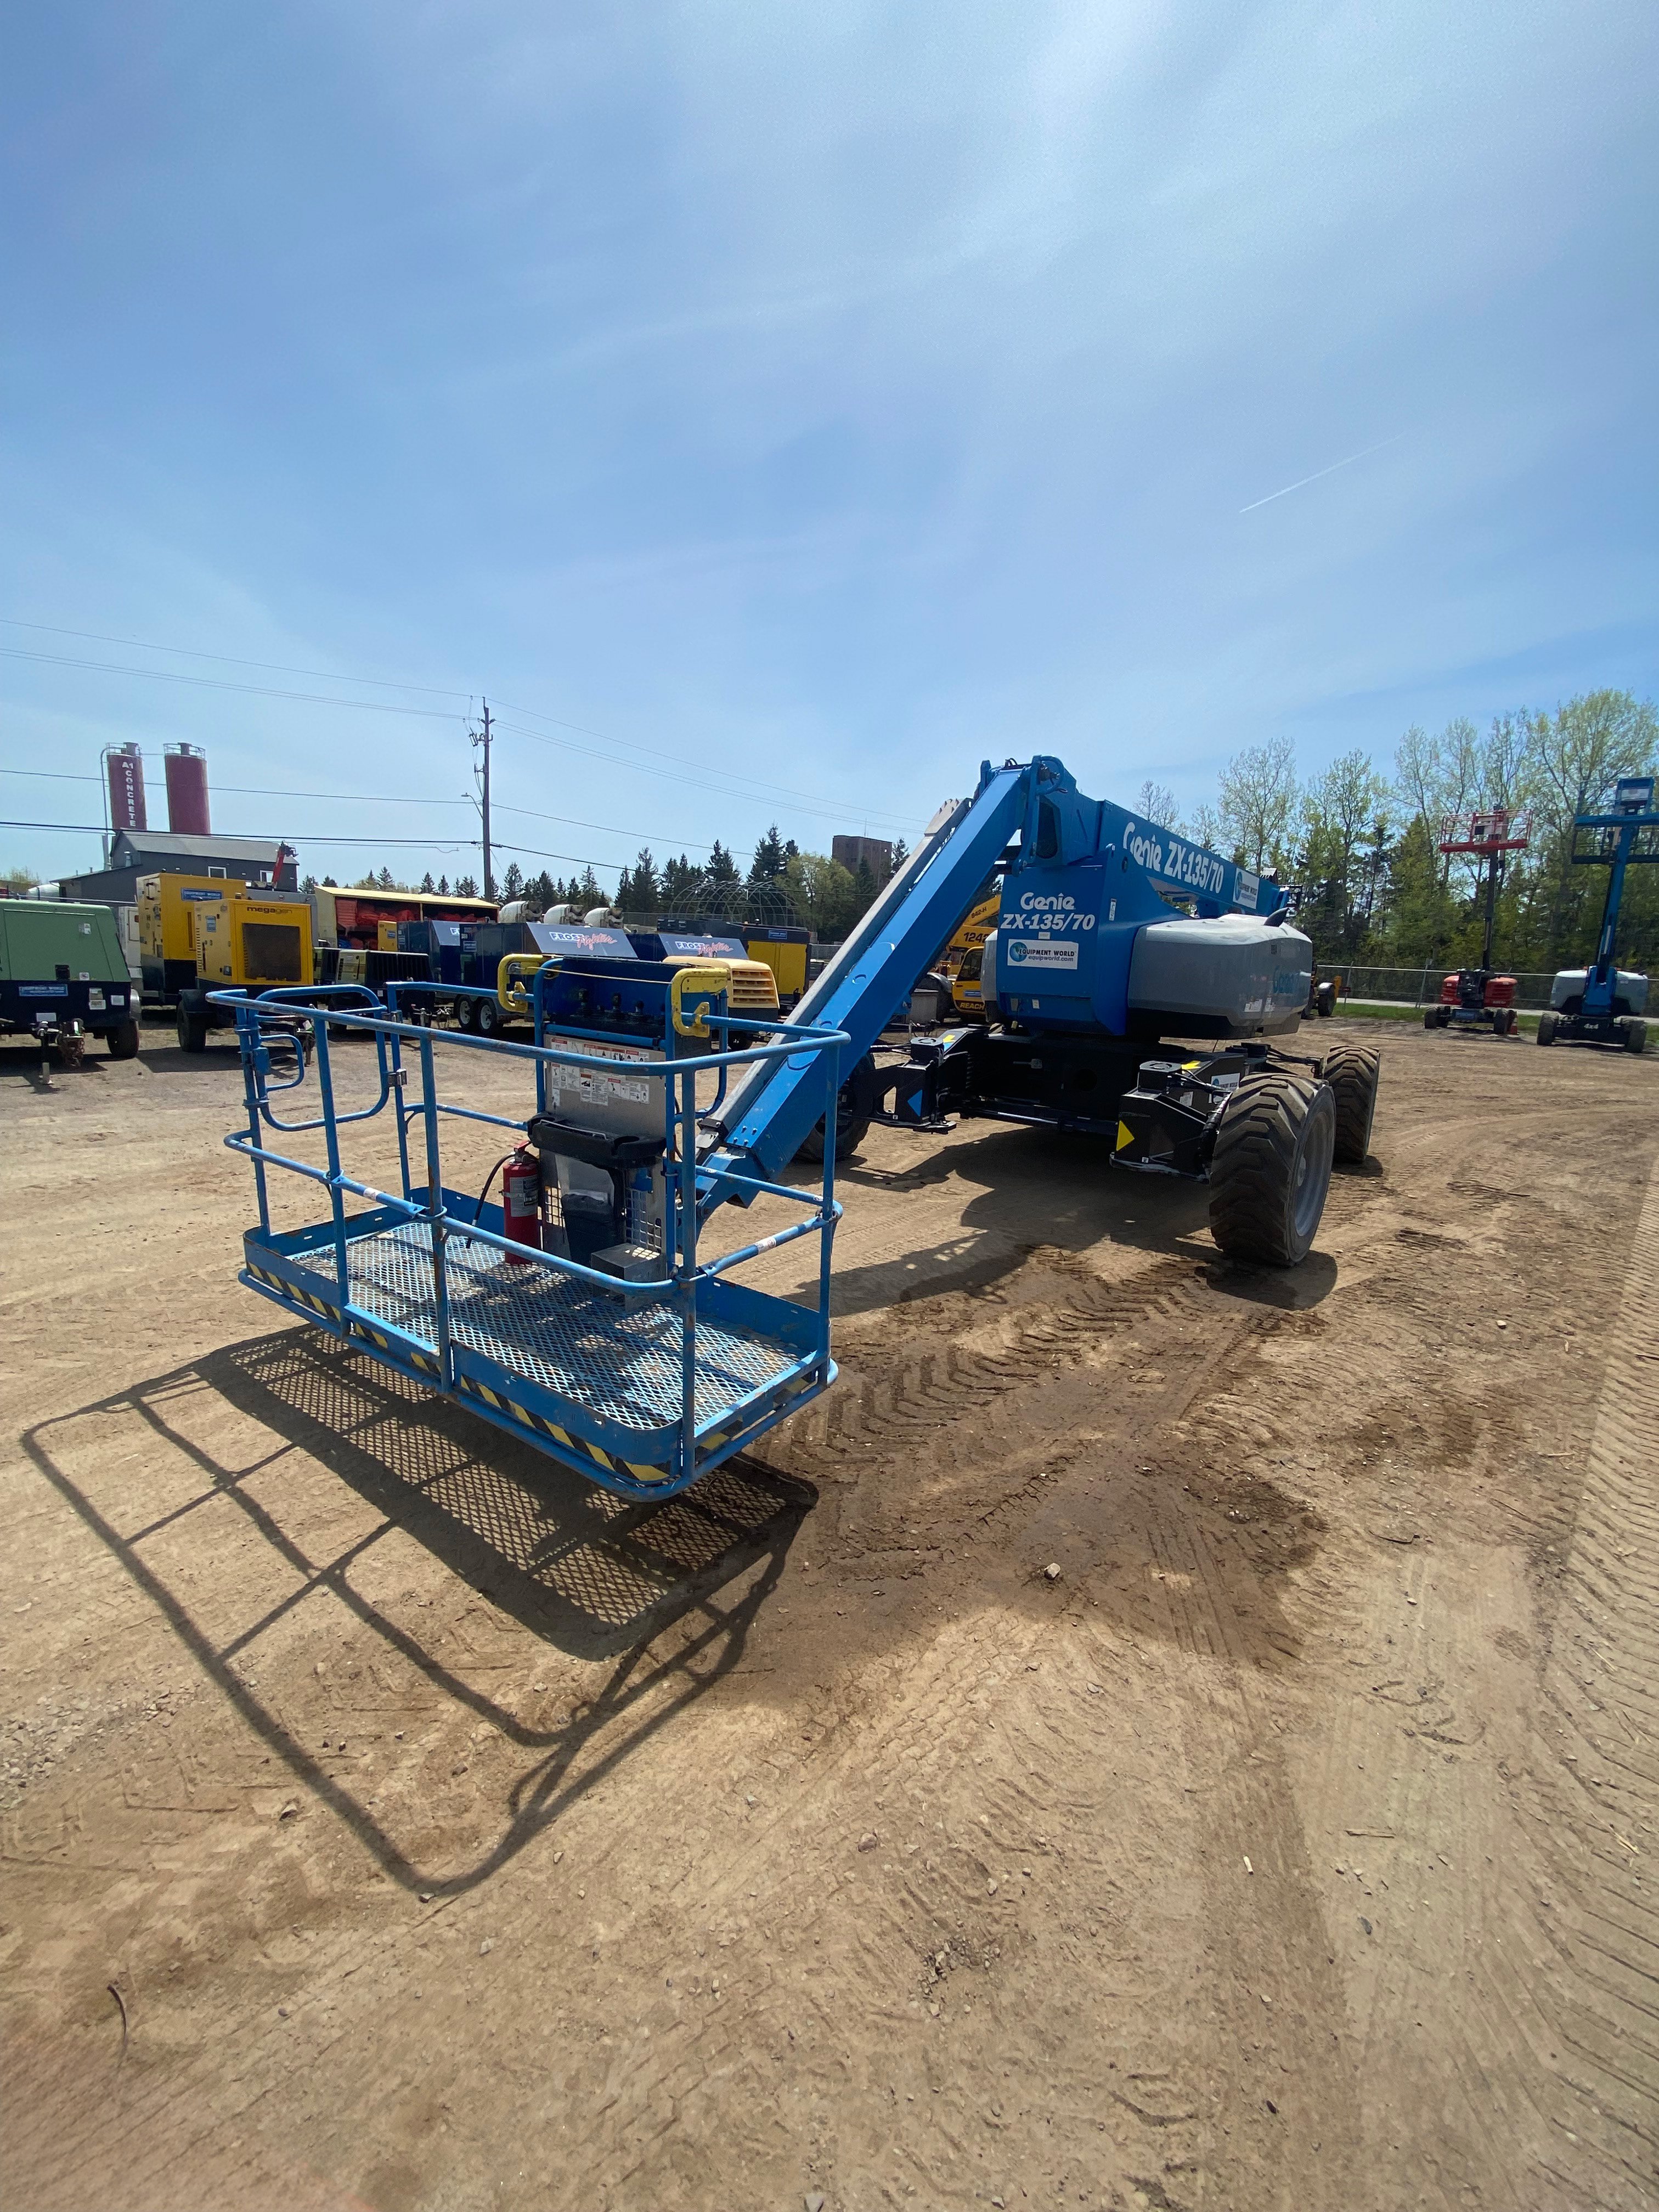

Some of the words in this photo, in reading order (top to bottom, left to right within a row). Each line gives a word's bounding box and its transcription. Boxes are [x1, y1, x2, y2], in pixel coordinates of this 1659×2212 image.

[125, 770, 136, 827] CONCRETE
[1123, 822, 1161, 872] Genie
[1164, 840, 1224, 894] ZX-135/70
[1020, 892, 1075, 910] Genie
[1000, 913, 1095, 931] ZX-135/70
[549, 932, 585, 943] FROST
[675, 941, 706, 950] FROST
[960, 1002, 985, 1010] REACH
